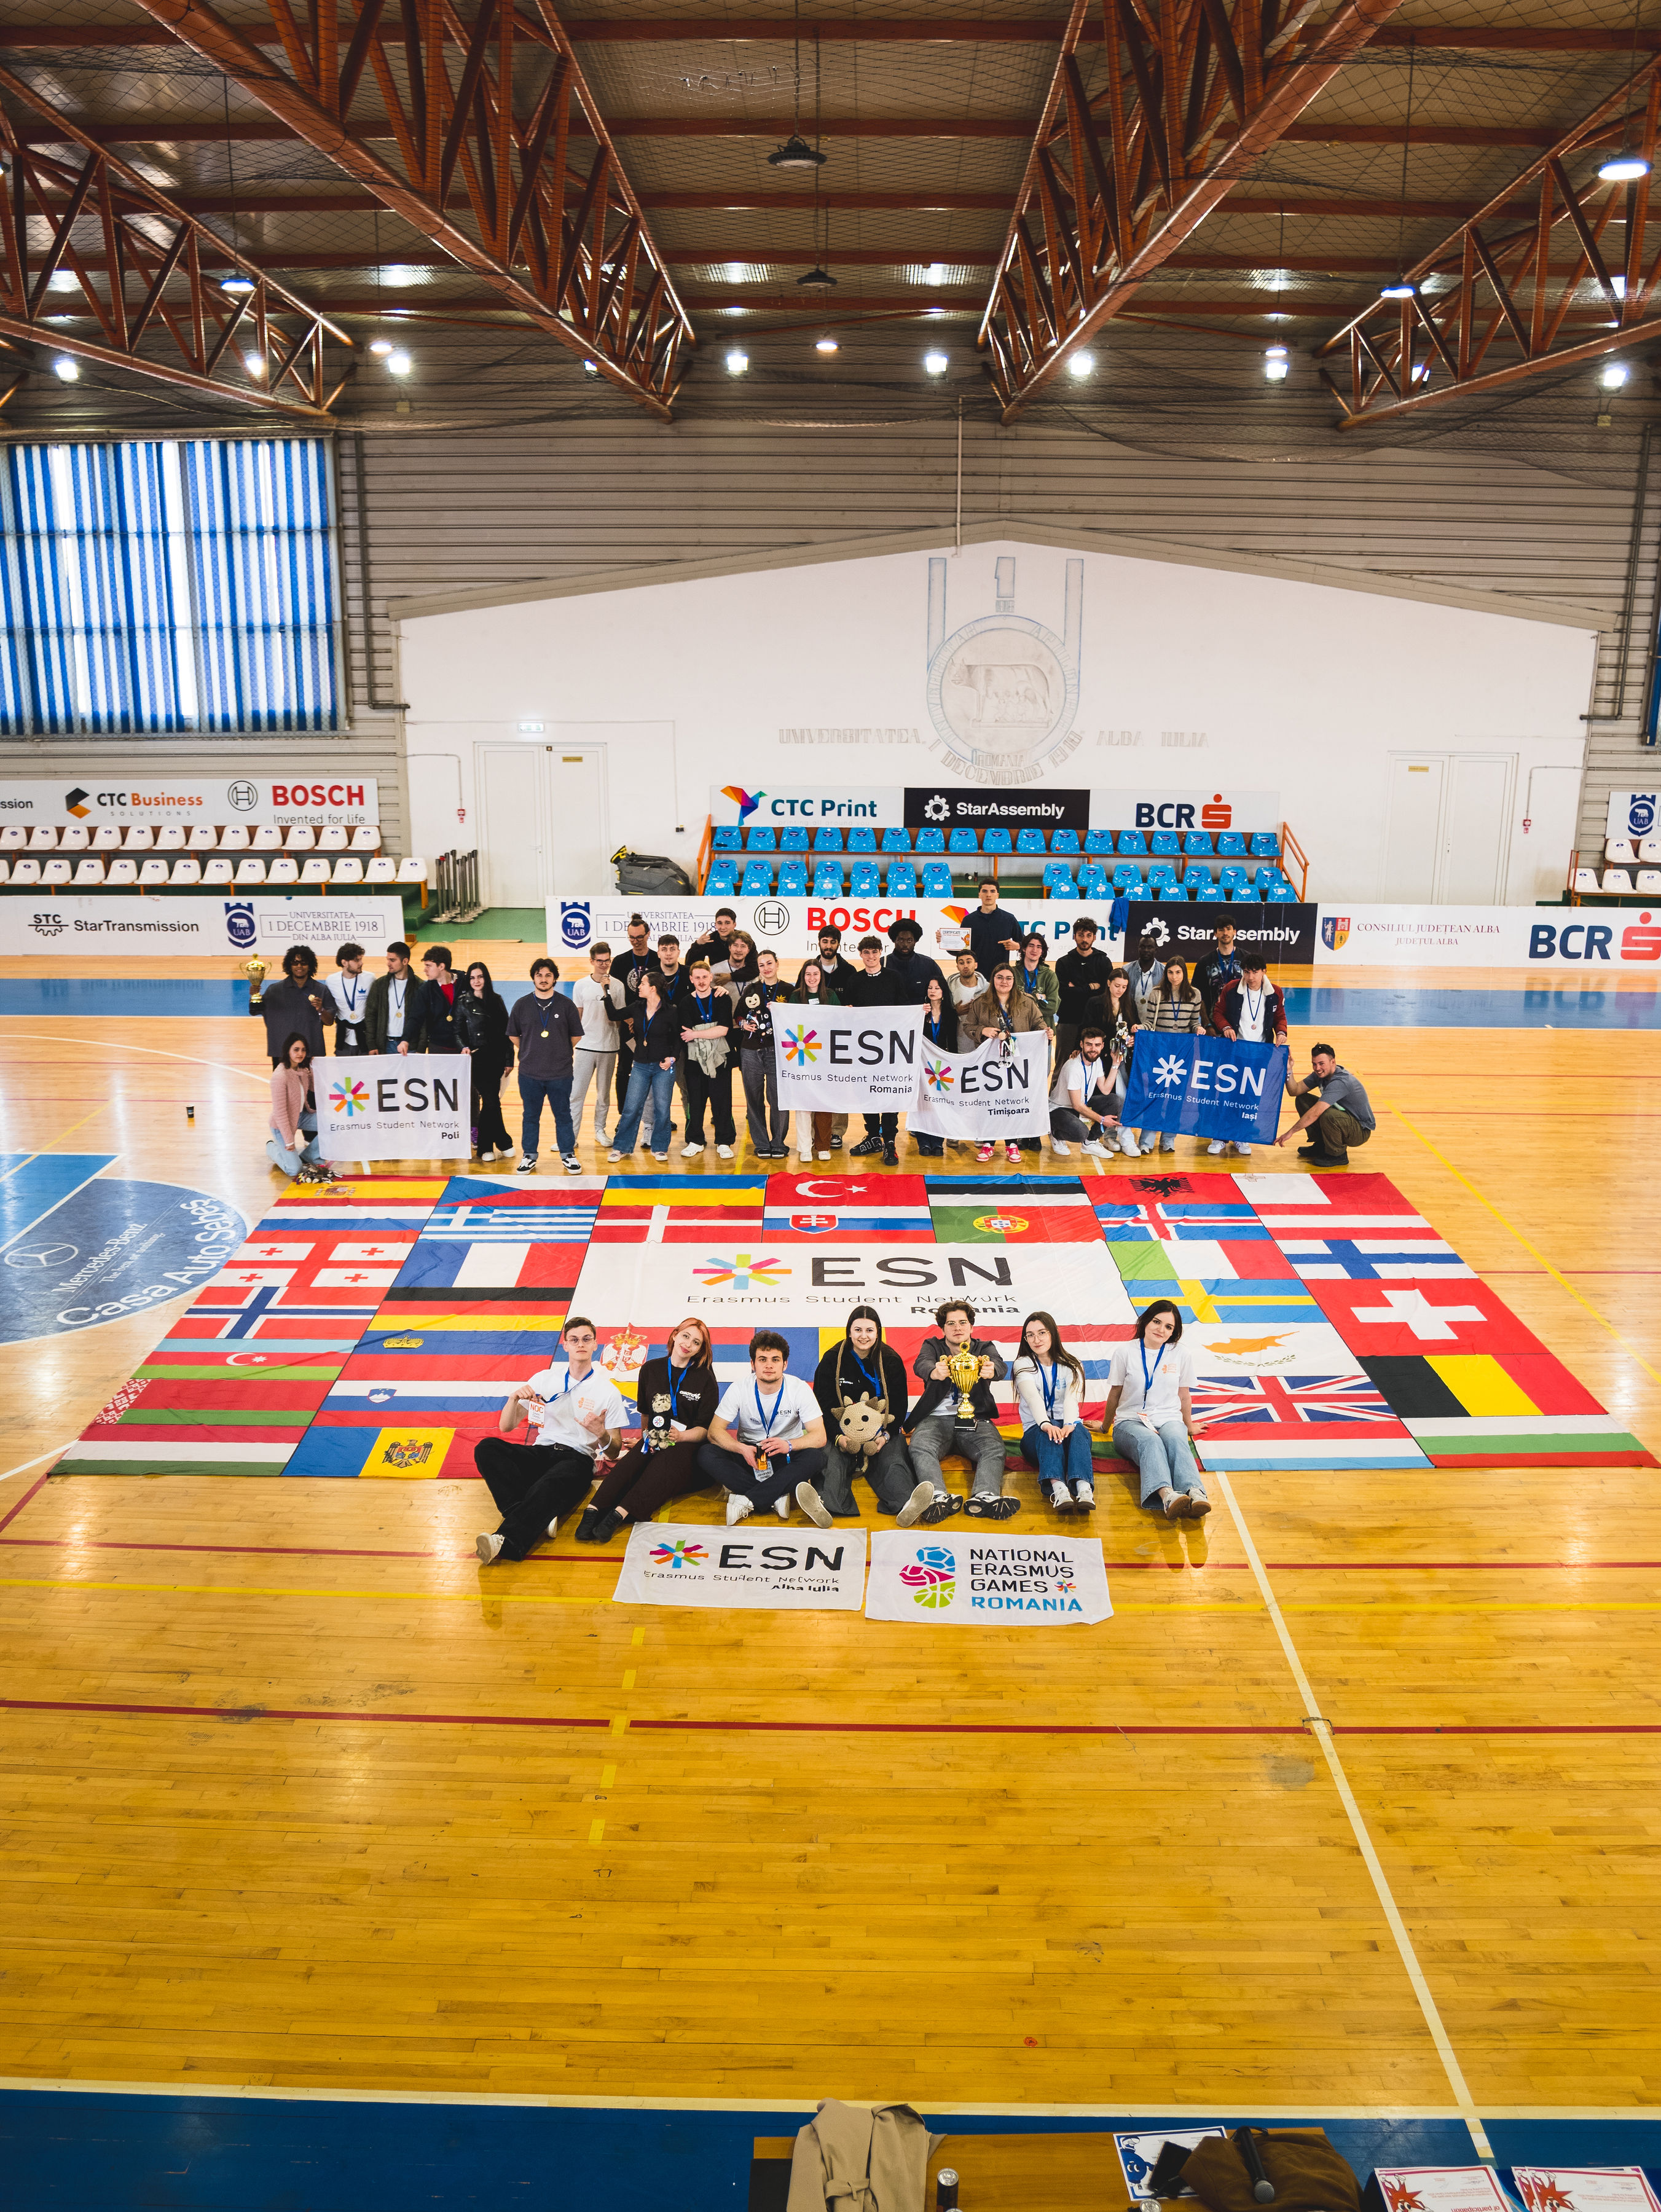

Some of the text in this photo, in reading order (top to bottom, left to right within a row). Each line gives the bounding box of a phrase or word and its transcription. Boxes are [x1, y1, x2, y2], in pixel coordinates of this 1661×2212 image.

[1096, 730, 1209, 748] ALBA IULIA
[940, 750, 1045, 786] DECEMBRIE
[96, 792, 203, 806] CTC Business
[272, 785, 364, 807] BOSCH
[771, 799, 877, 817] CTC Print
[956, 801, 1065, 819] StarAssembly
[273, 814, 365, 824] Invented for life
[1135, 802, 1195, 829] BCR
[33, 914, 62, 924] STC
[74, 920, 200, 932] StarTransmission
[277, 921, 351, 932] DECEMBRIE
[355, 921, 379, 932] 1918
[613, 921, 689, 932] DEMBRIE
[1357, 923, 1414, 933] CONSILIUL
[1472, 925, 1500, 933] ALBA
[1528, 924, 1612, 960] BCR
[830, 1029, 915, 1065] ESN
[782, 1070, 822, 1081] Erasmus
[827, 1074, 867, 1083] Student
[960, 1058, 1029, 1094] ESN
[1190, 1060, 1266, 1096] ESN
[377, 1078, 458, 1112] ESN
[870, 1085, 912, 1094] Romania
[924, 1094, 1029, 1107] Erasmus Student Network
[1148, 1092, 1259, 1111] Erasmus Student Network
[988, 1107, 1030, 1117] Timișoara
[1241, 1112, 1257, 1121] Iași
[330, 1122, 371, 1131] Erasmus
[420, 1120, 460, 1129] Network
[441, 1131, 460, 1140] Poli
[52, 1223, 147, 1293] Mercedes-Benz
[99, 1272, 122, 1283] The
[811, 1257, 1013, 1287] ESN
[57, 1284, 179, 1325] Casa
[162, 1245, 231, 1284] Auto
[686, 1295, 790, 1304] Erasmus
[805, 1295, 902, 1303] Student
[530, 1403, 543, 1413] NOC
[719, 1544, 844, 1572] ESN
[970, 1548, 1074, 1564] NATIONAL
[644, 1571, 705, 1581] Erasmus
[713, 1574, 771, 1583] Student
[970, 1563, 1074, 1579] ERASMUS
[807, 1584, 839, 1593] Iulia
[970, 1579, 1048, 1593] GAMES
[972, 1596, 1083, 1612] ROMANIA
